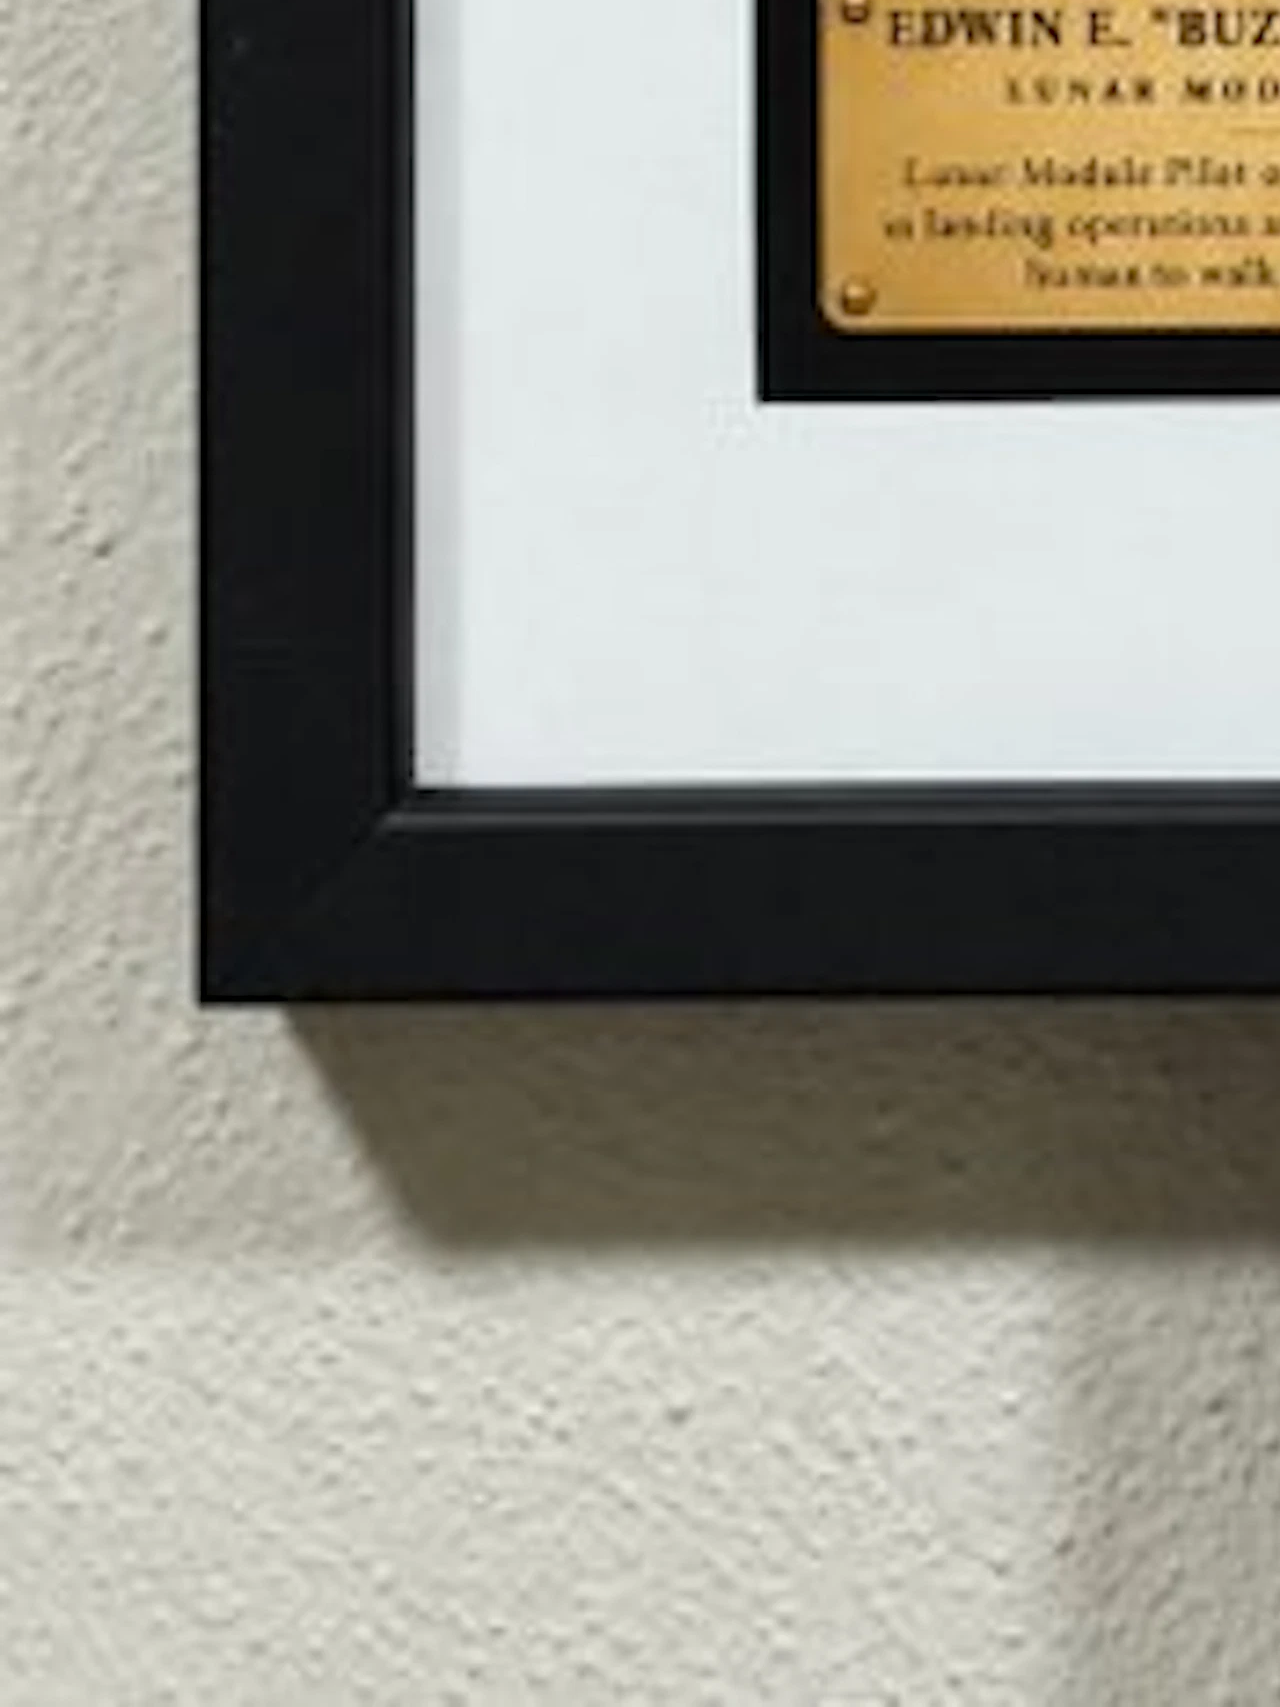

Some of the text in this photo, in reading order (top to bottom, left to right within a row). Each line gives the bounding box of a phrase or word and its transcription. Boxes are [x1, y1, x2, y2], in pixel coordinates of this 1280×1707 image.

[888, 7, 1063, 49] EDWIN
[1085, 7, 1133, 49] E.
[1005, 76, 1156, 105] LUNAR
[902, 157, 1003, 189] Lunar
[1018, 157, 1153, 189] Module
[1164, 157, 1247, 189] Pilot
[922, 207, 1056, 249] landing
[1064, 209, 1252, 247] operations
[1022, 255, 1142, 291] human
[1150, 257, 1190, 289] to
[1200, 255, 1274, 289] walk
